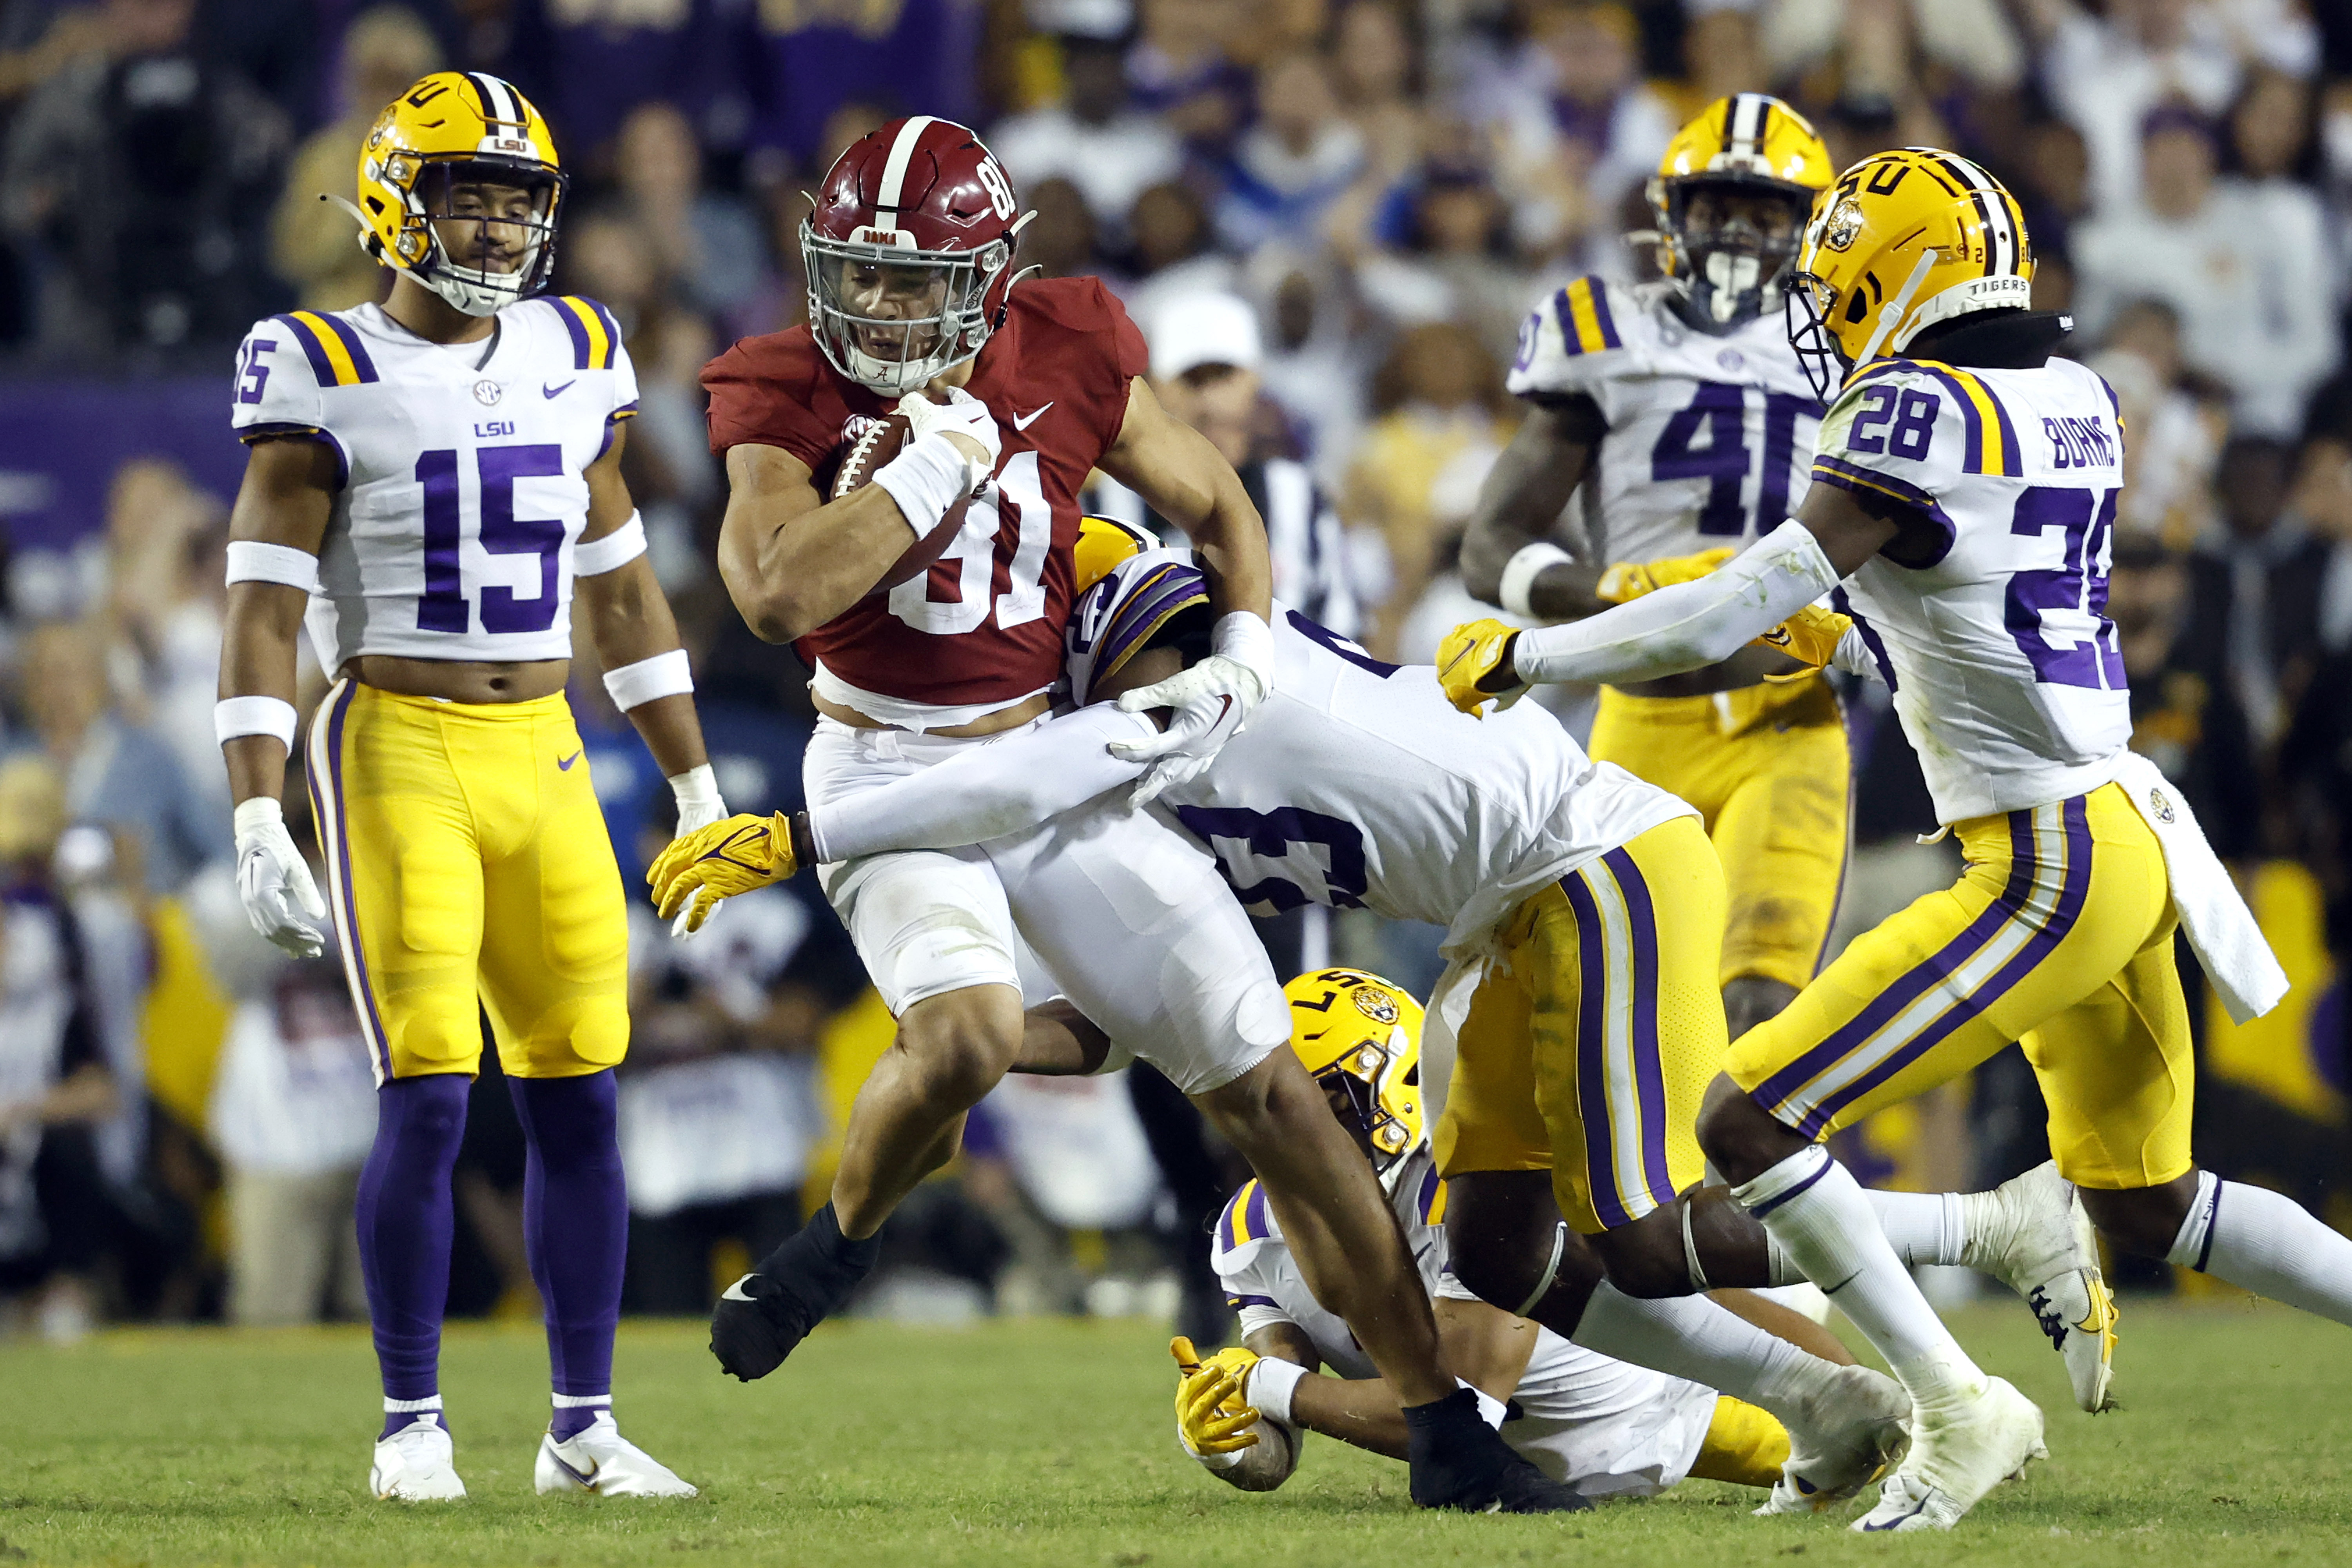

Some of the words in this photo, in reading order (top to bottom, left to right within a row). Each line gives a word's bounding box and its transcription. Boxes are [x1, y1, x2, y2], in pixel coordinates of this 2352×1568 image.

[494, 139, 526, 152] LSU
[976, 155, 1016, 221] 81
[1968, 279, 2026, 296] TIGERS
[474, 420, 515, 437] LSU
[1847, 385, 1940, 462] 28
[2042, 416, 2115, 469] BURNS
[415, 444, 566, 634] 15
